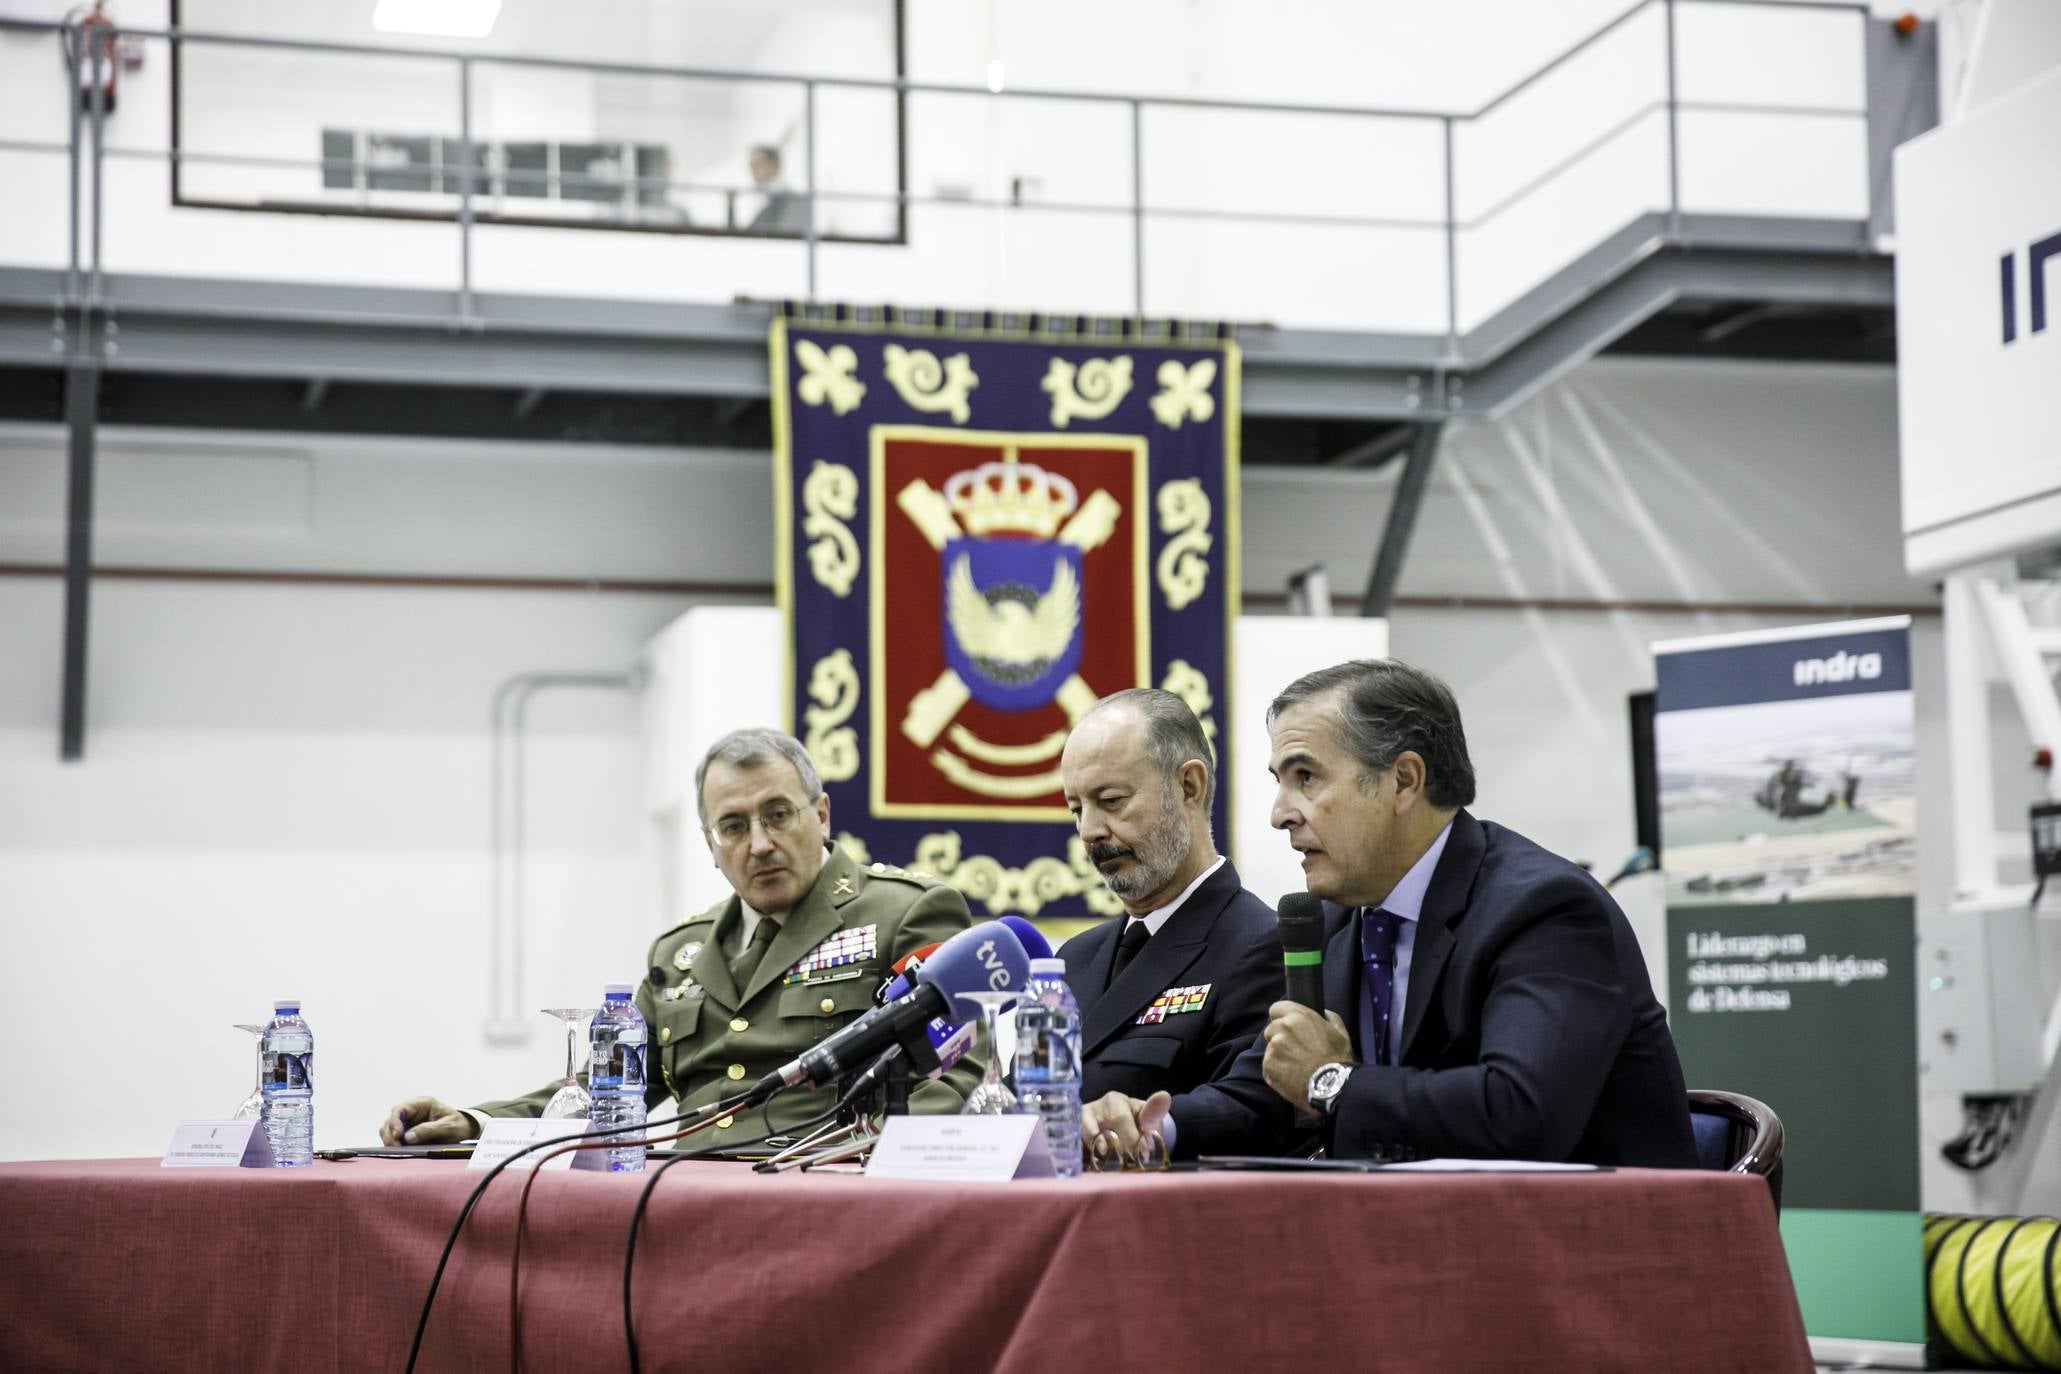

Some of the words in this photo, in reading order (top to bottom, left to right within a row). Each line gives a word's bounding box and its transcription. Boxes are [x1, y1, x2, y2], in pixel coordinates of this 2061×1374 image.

[1794, 650, 1882, 686] indra
[976, 940, 1011, 992] tve
[1687, 960, 1767, 985] sistemas
[1687, 986, 1712, 1012] de
[1714, 985, 1792, 1012] Defensa
